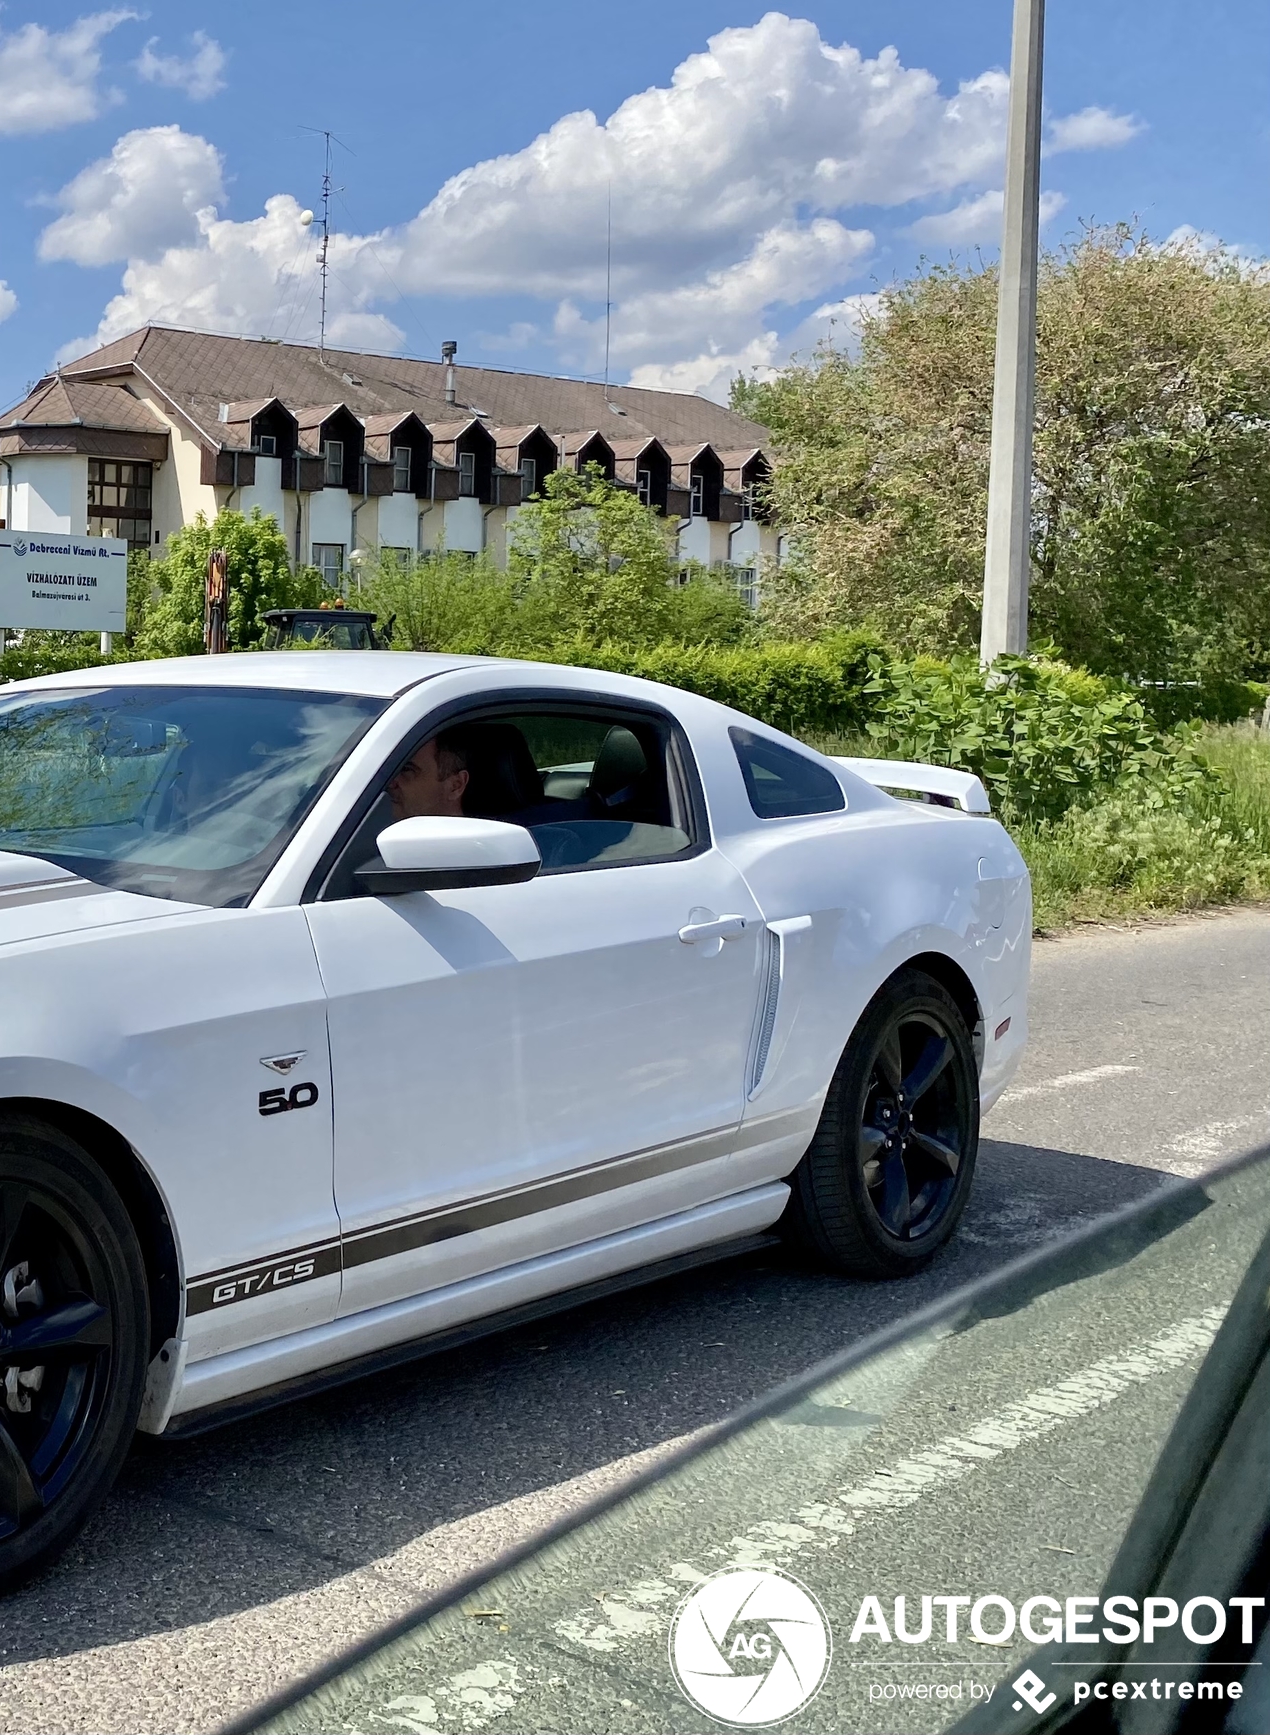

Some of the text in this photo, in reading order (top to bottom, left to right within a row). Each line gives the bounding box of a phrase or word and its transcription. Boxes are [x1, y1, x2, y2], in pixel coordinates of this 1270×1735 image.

[29, 542, 71, 555] Debreceni
[98, 548, 110, 558] Rt.
[212, 1258, 315, 1303] GT/CS
